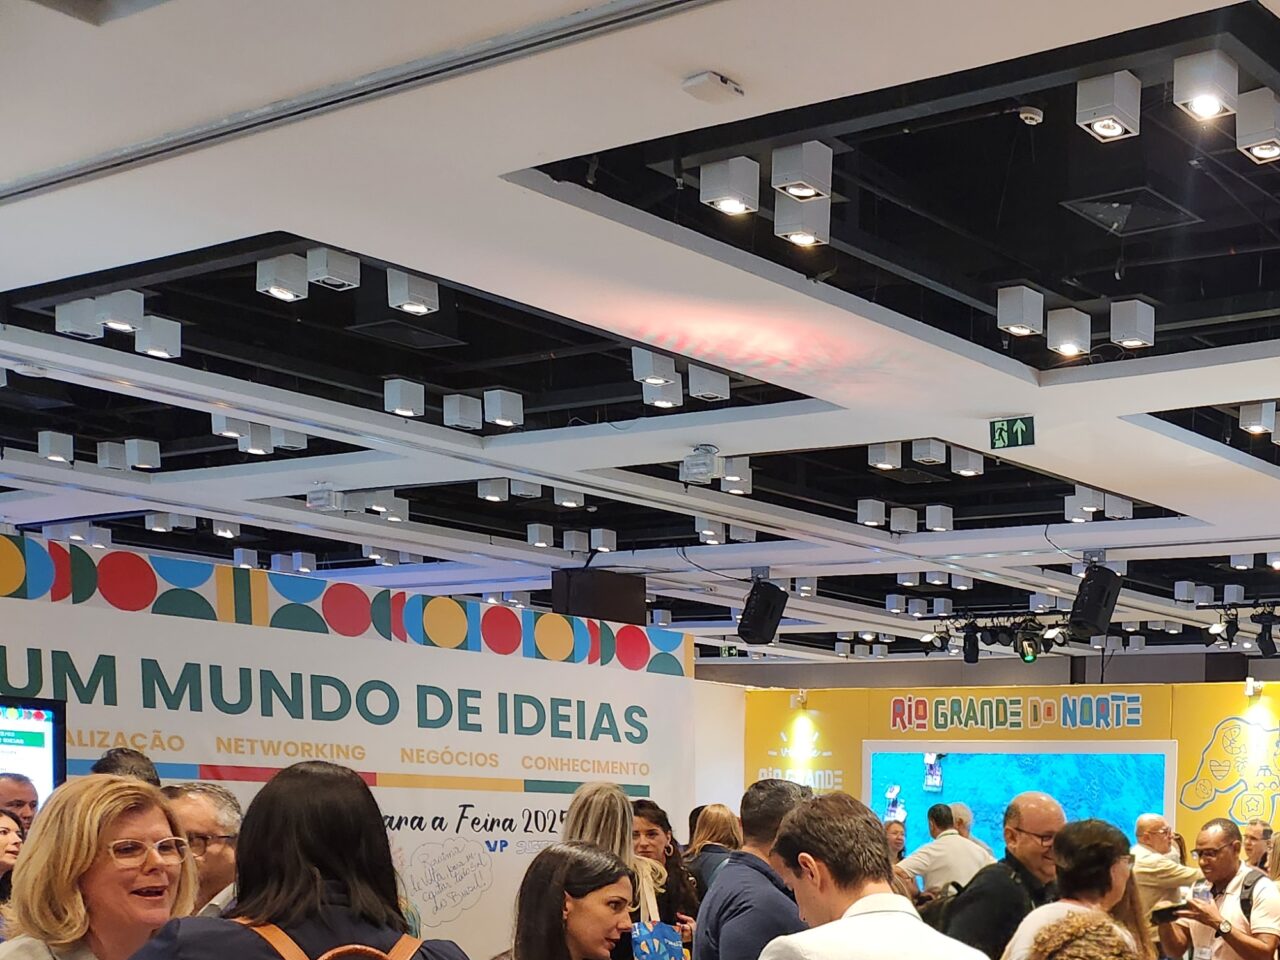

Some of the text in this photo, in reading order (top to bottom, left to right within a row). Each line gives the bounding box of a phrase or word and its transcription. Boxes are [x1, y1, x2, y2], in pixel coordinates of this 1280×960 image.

[0, 644, 649, 745] UM MUNDO DE IDEIAS
[932, 695, 1023, 731] GRANDE
[1061, 692, 1142, 730] NORTE
[216, 736, 366, 761] NETWORKING
[400, 746, 499, 768] NEGÓCIOS
[521, 755, 650, 777] CONHECIMENTO
[383, 814, 427, 831] ara
[431, 816, 448, 831] a
[455, 804, 518, 834] Feira
[485, 839, 508, 852] VP
